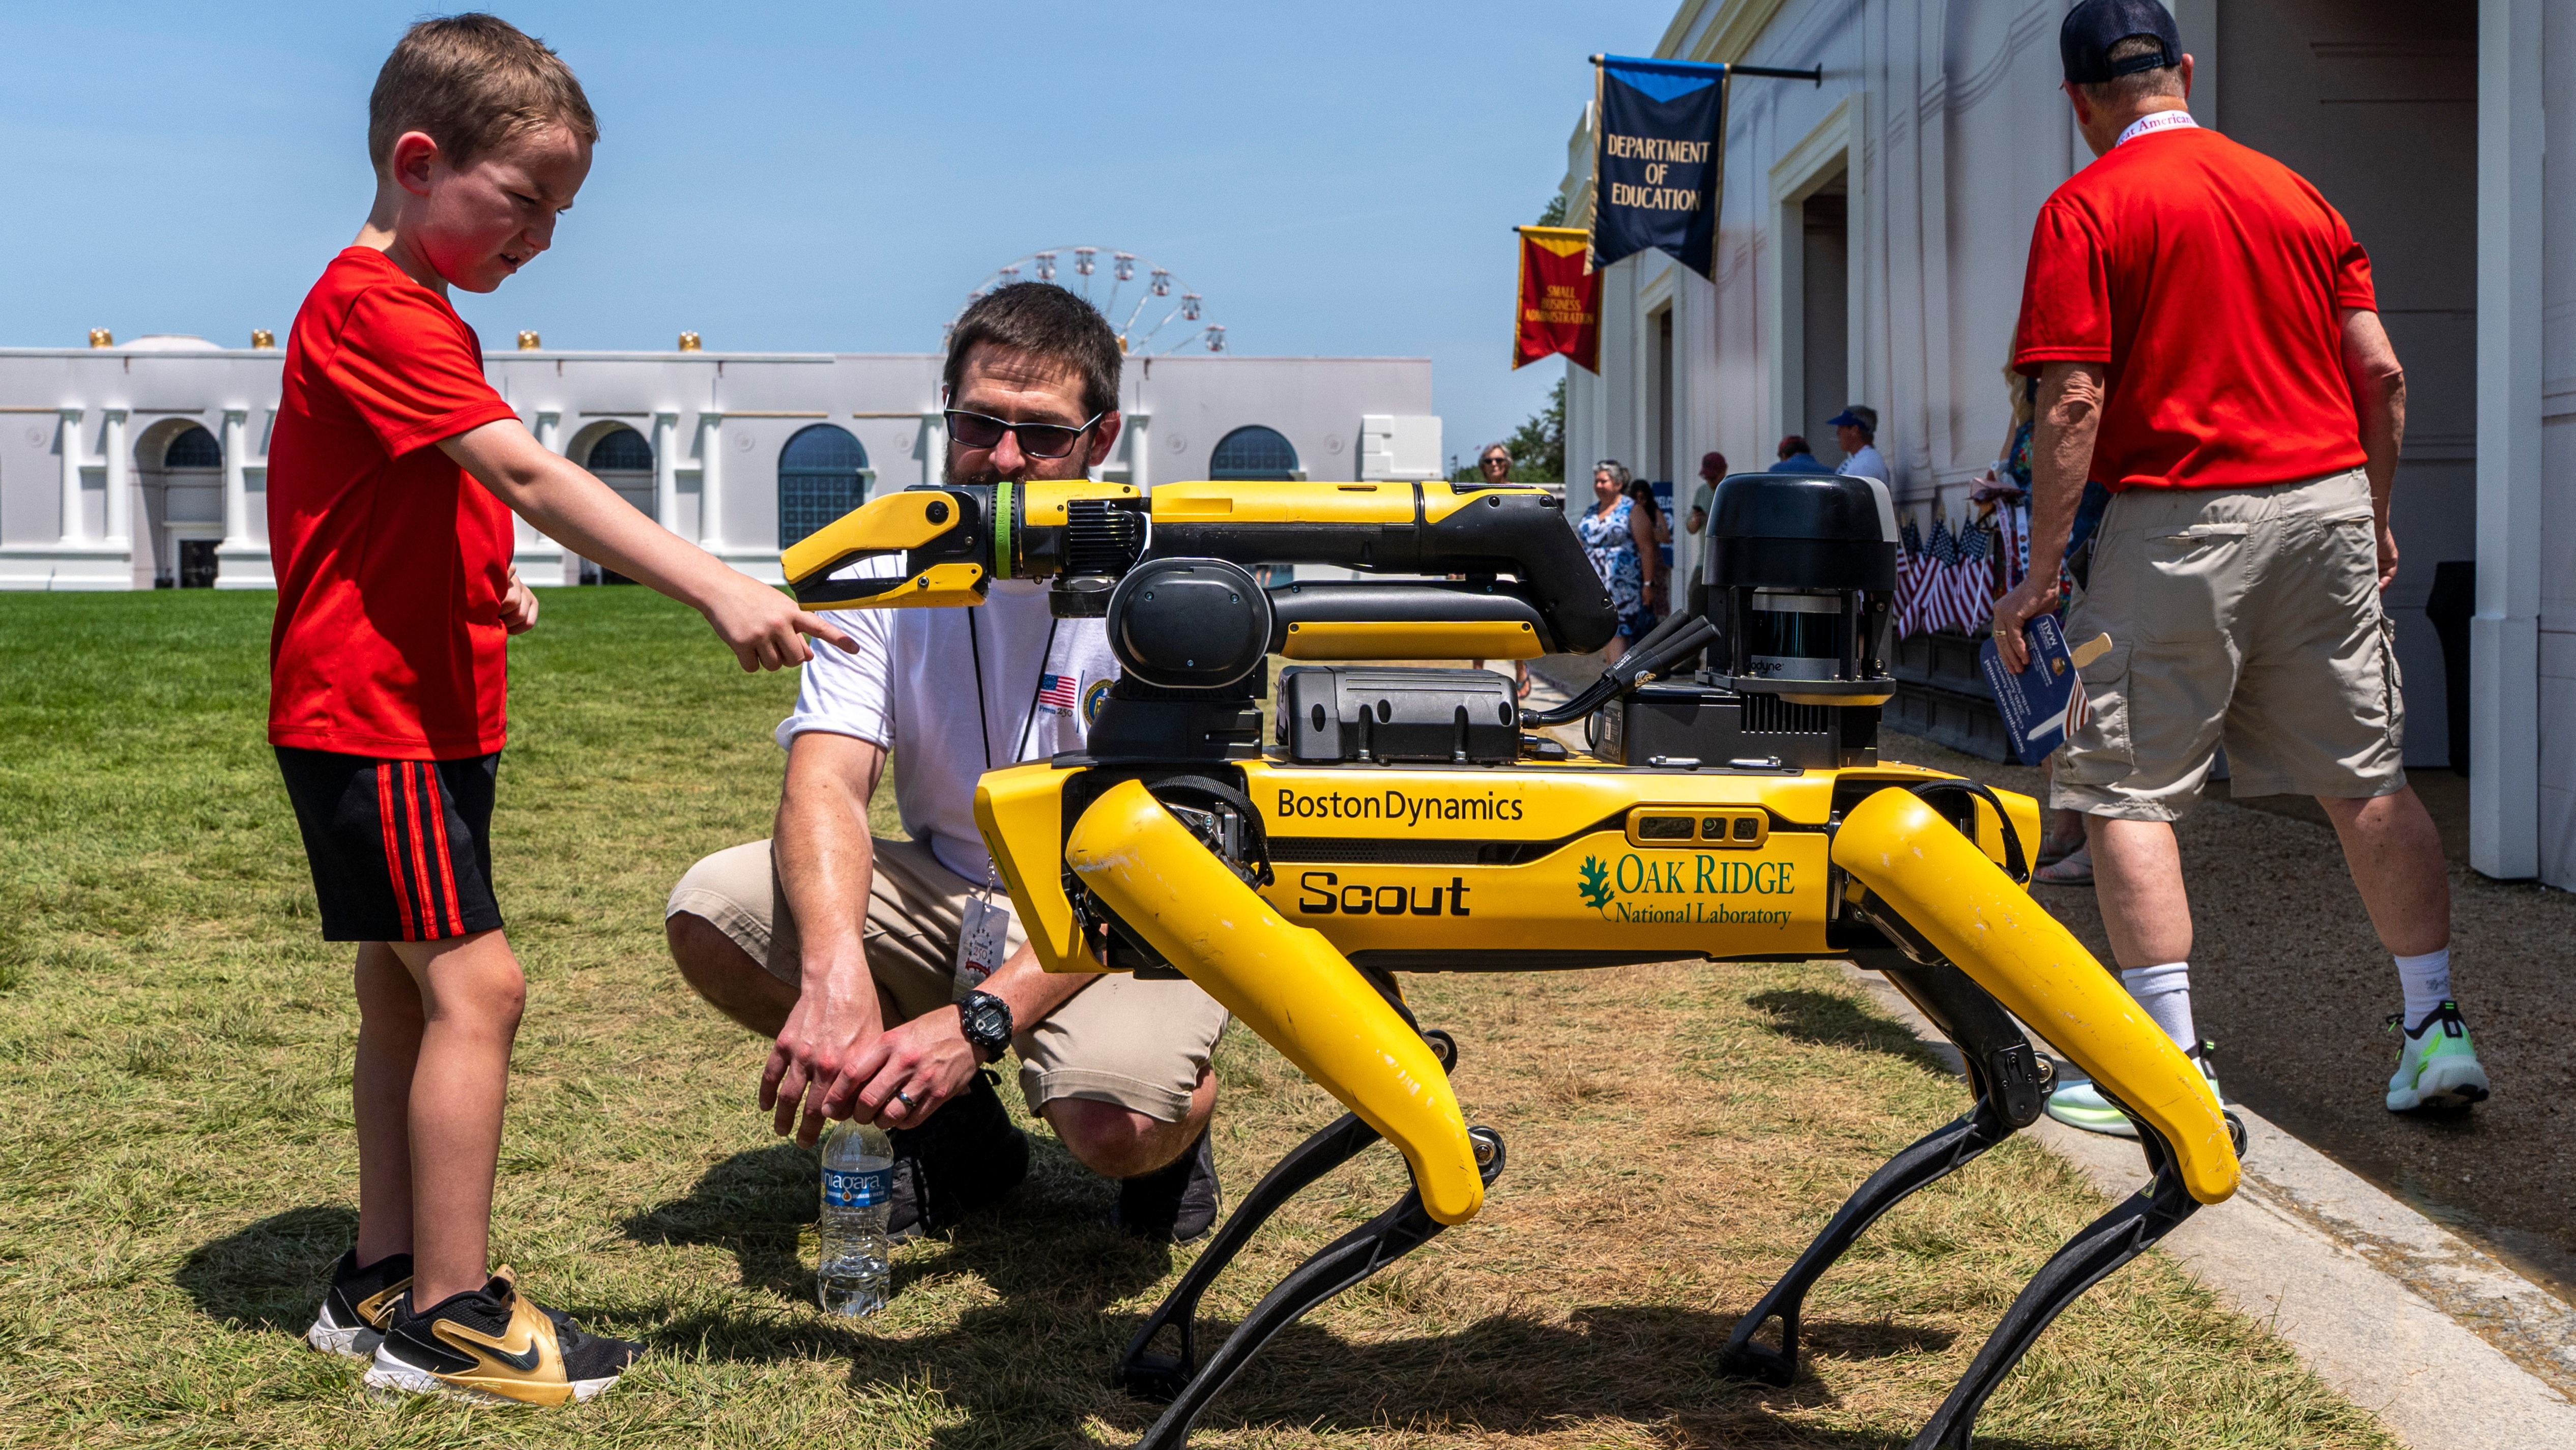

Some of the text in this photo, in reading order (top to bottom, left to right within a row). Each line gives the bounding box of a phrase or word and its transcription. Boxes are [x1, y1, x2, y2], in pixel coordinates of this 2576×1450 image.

[2139, 113, 2192, 132] American
[1607, 133, 1711, 163] DEPARTMENT
[1645, 163, 1668, 185] OF
[1611, 182, 1701, 211] EDUCATION
[1547, 284, 1575, 298] SMALL
[998, 505, 1007, 525] Ridge
[2042, 618, 2058, 646] MALL
[1751, 660, 1782, 674] odyne
[1992, 655, 2024, 730] Celebrating America's
[2012, 674, 2032, 715] on the Natio
[1057, 708, 1073, 717] 250
[2014, 693, 2025, 716] 250th
[1616, 853, 1795, 894] OAK RIDGE
[1299, 872, 1470, 916] Scout
[1615, 902, 1791, 930] National Laboratory
[973, 946, 988, 961] 250
[825, 1172, 880, 1194] niagara
